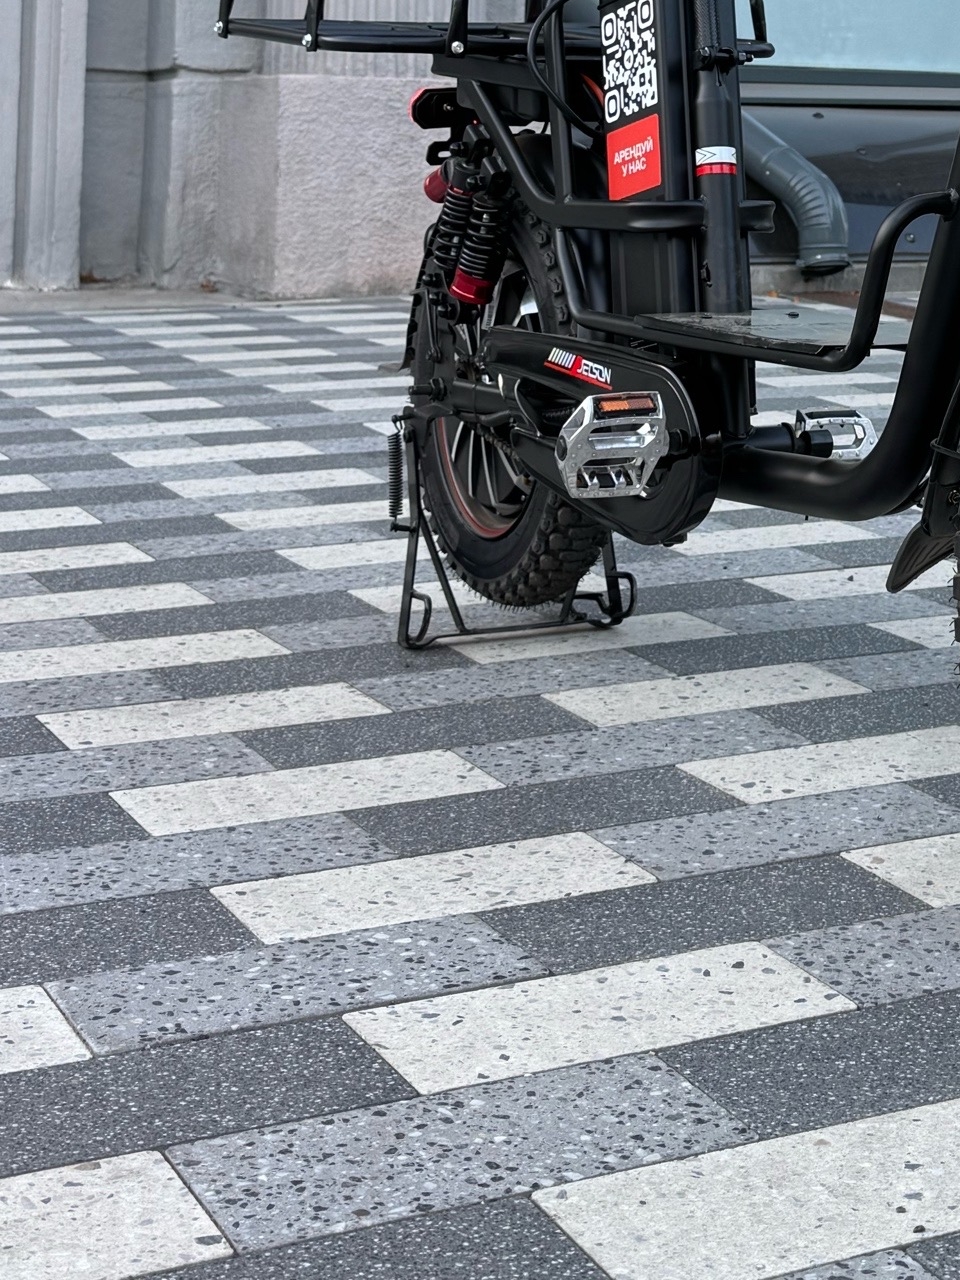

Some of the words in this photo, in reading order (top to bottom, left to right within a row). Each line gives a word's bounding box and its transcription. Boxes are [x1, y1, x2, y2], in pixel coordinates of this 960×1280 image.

[613, 135, 654, 166] АРЕНДУЙ
[621, 163, 628, 178] У
[628, 157, 647, 175] НАС
